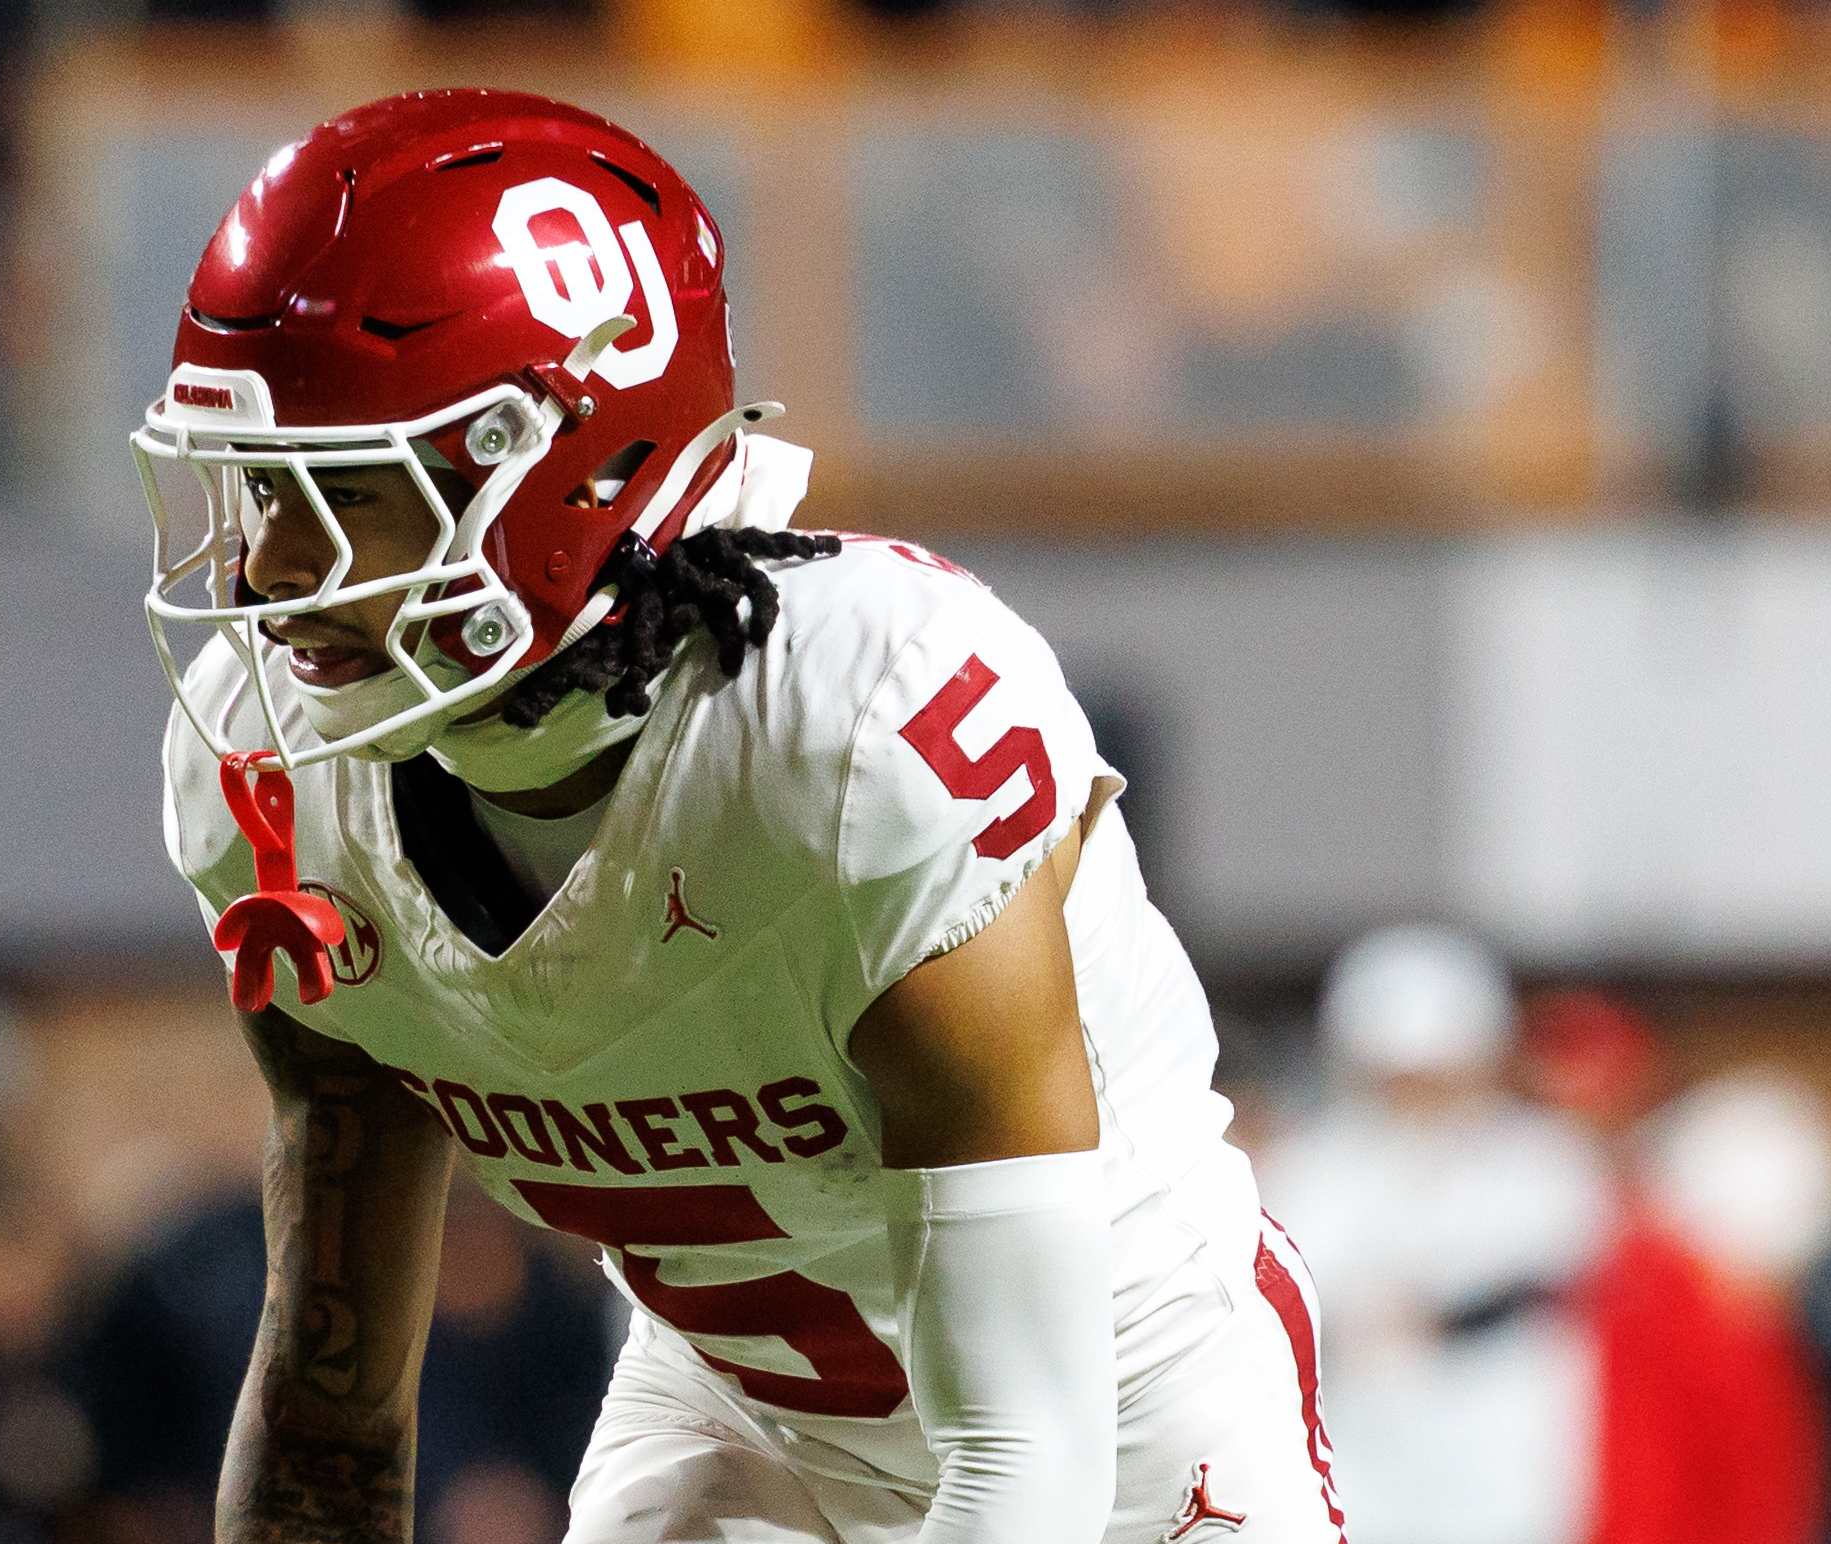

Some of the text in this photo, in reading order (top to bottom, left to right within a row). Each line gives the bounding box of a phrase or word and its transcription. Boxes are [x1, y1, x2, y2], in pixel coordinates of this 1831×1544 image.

[491, 176, 680, 391] OU
[898, 652, 1057, 860] 5
[508, 1178, 910, 1419] 5
